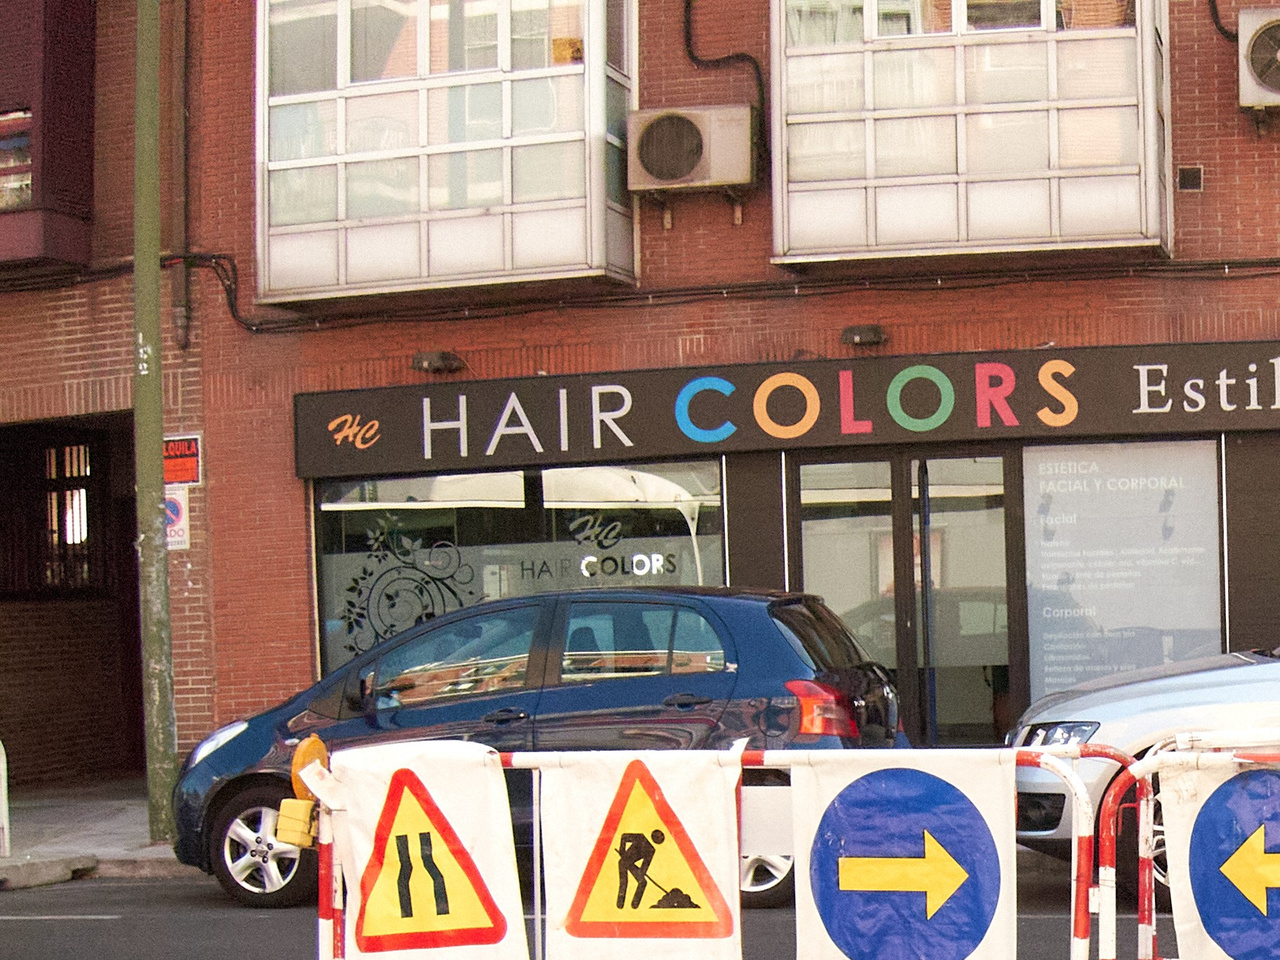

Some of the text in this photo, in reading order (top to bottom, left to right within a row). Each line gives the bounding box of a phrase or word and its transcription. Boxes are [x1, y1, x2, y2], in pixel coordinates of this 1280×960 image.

[423, 385, 634, 459] HAIR
[674, 359, 1079, 443] COLORS
[1039, 475, 1185, 494] FACIAL Y CORPORAL
[1040, 512, 1077, 525] Facial
[520, 553, 677, 580] HAIR COLORS
[1042, 605, 1096, 619] Corporal
